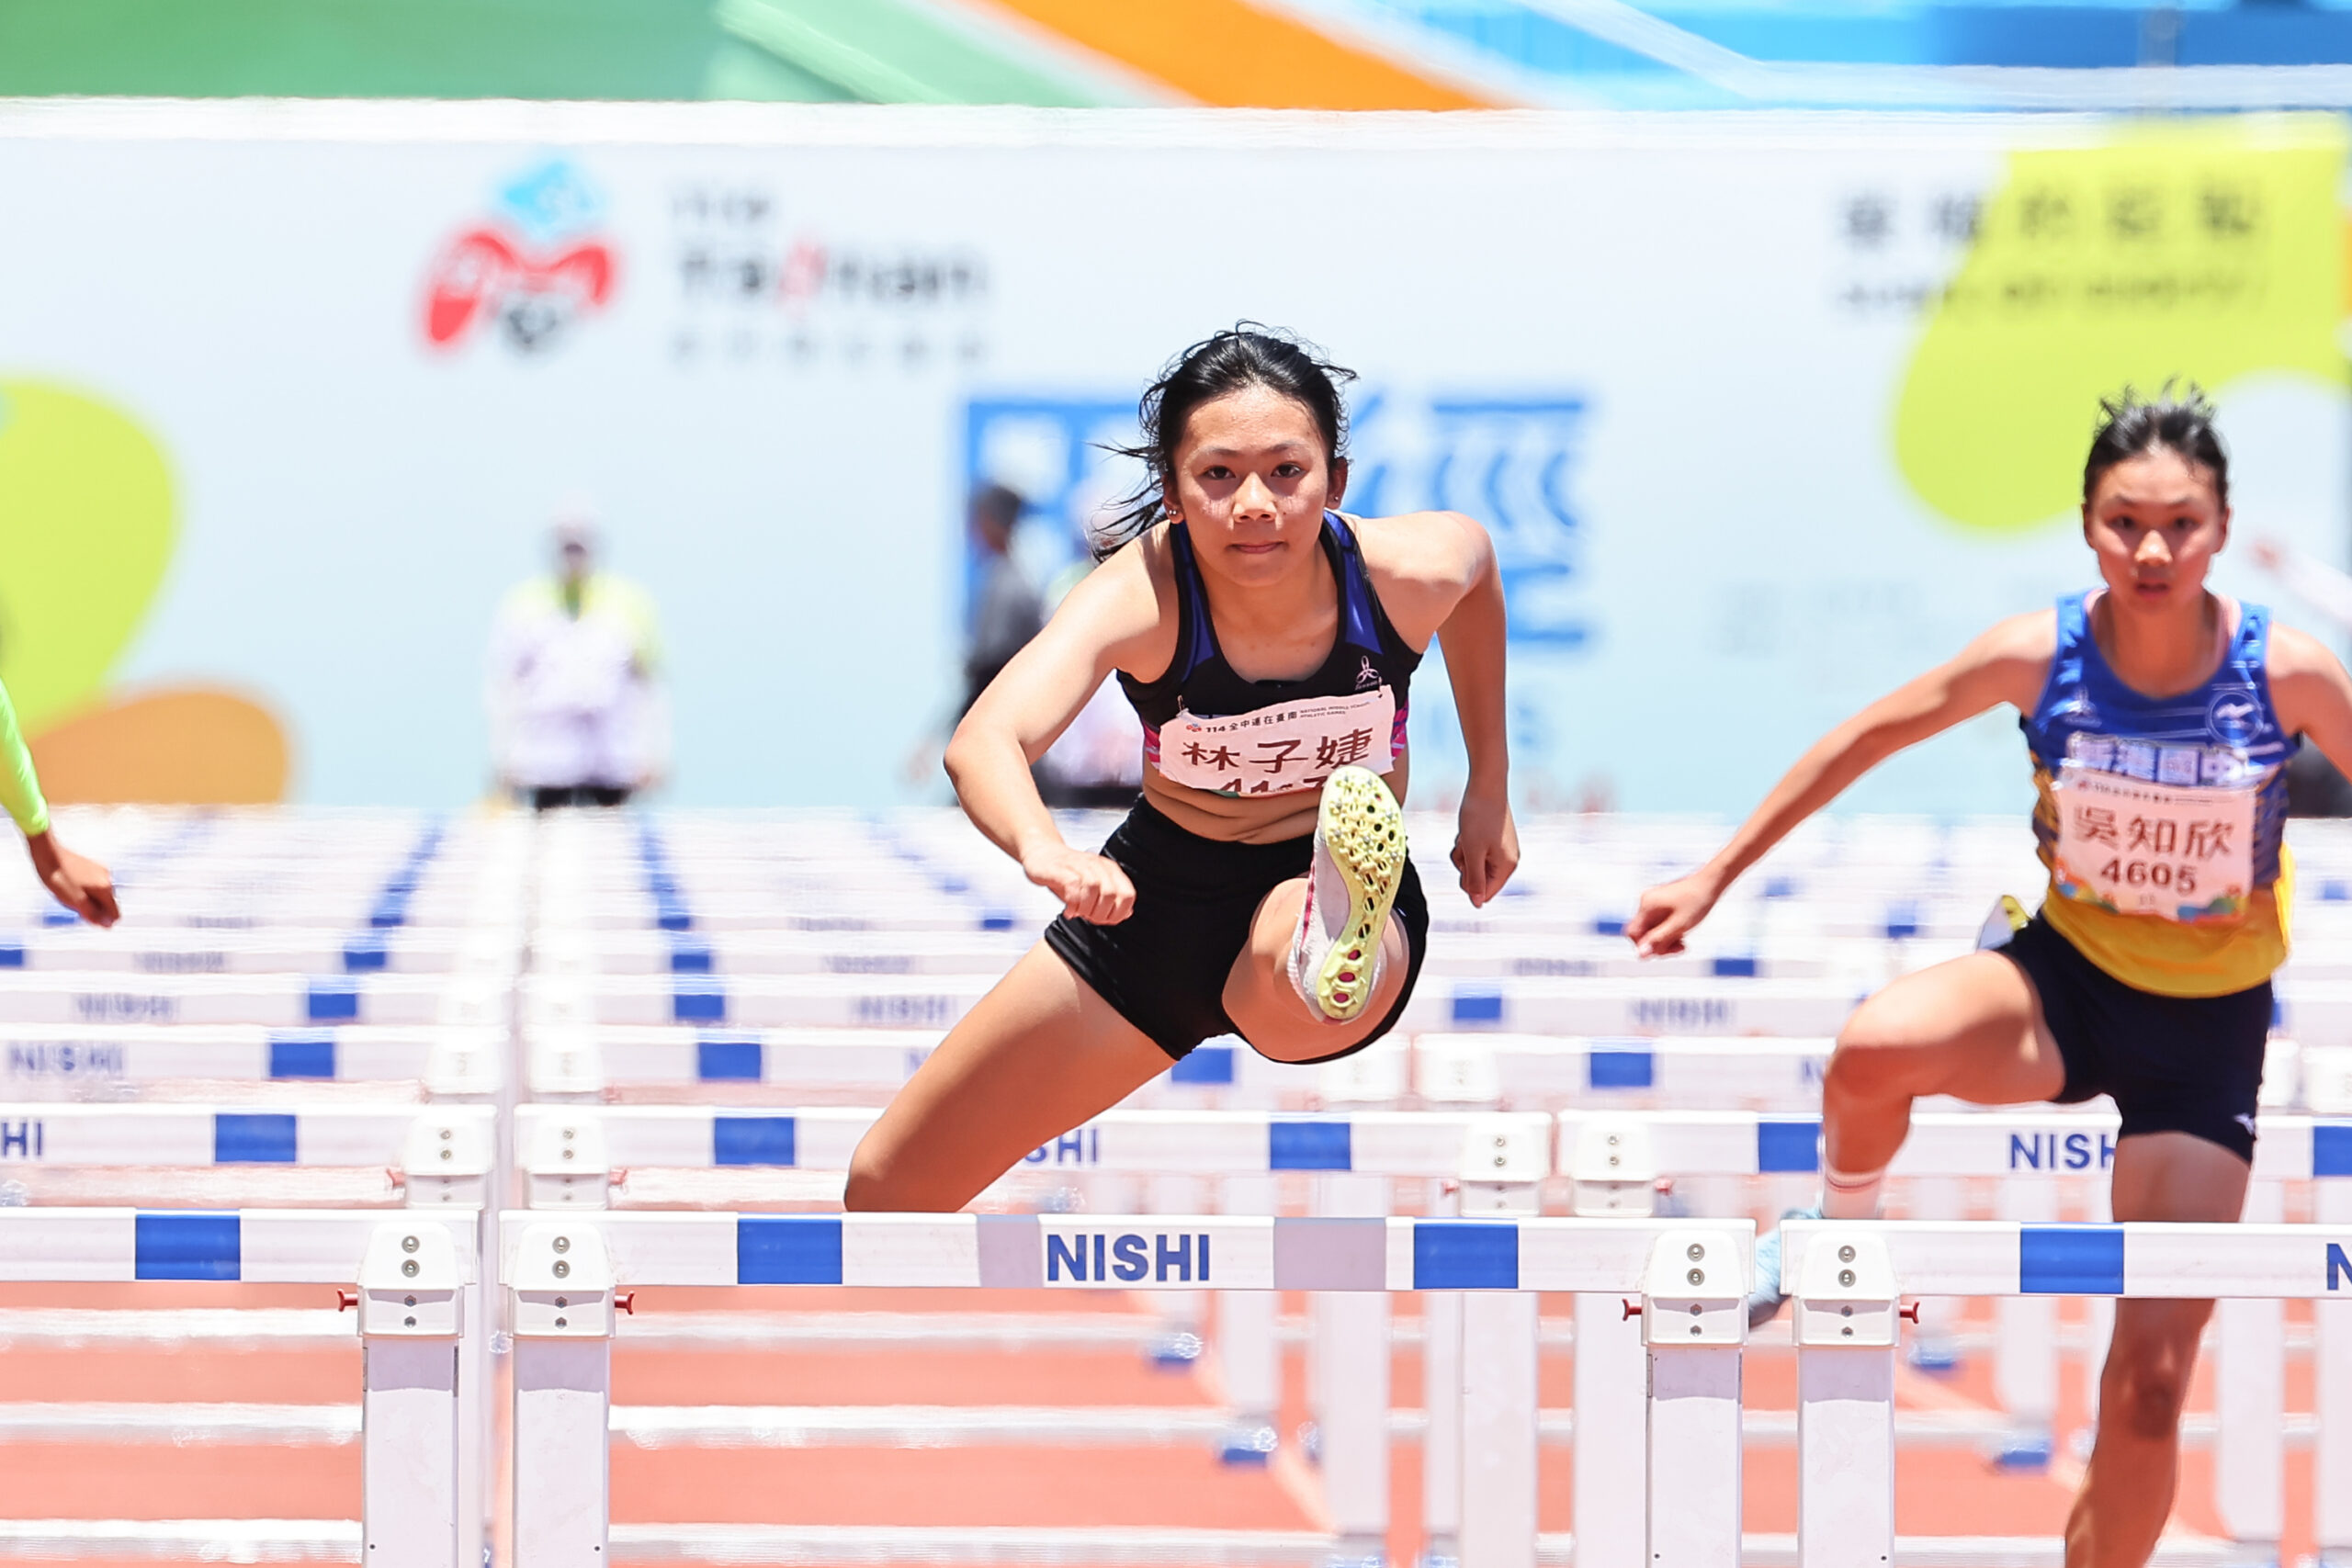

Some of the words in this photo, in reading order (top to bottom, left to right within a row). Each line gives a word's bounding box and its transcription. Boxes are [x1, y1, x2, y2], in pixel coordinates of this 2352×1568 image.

[1182, 728, 1373, 773] 林子婕
[2100, 855, 2197, 895] 4605
[2009, 1133, 2116, 1169] NISH
[1046, 1233, 1211, 1283] NISHI
